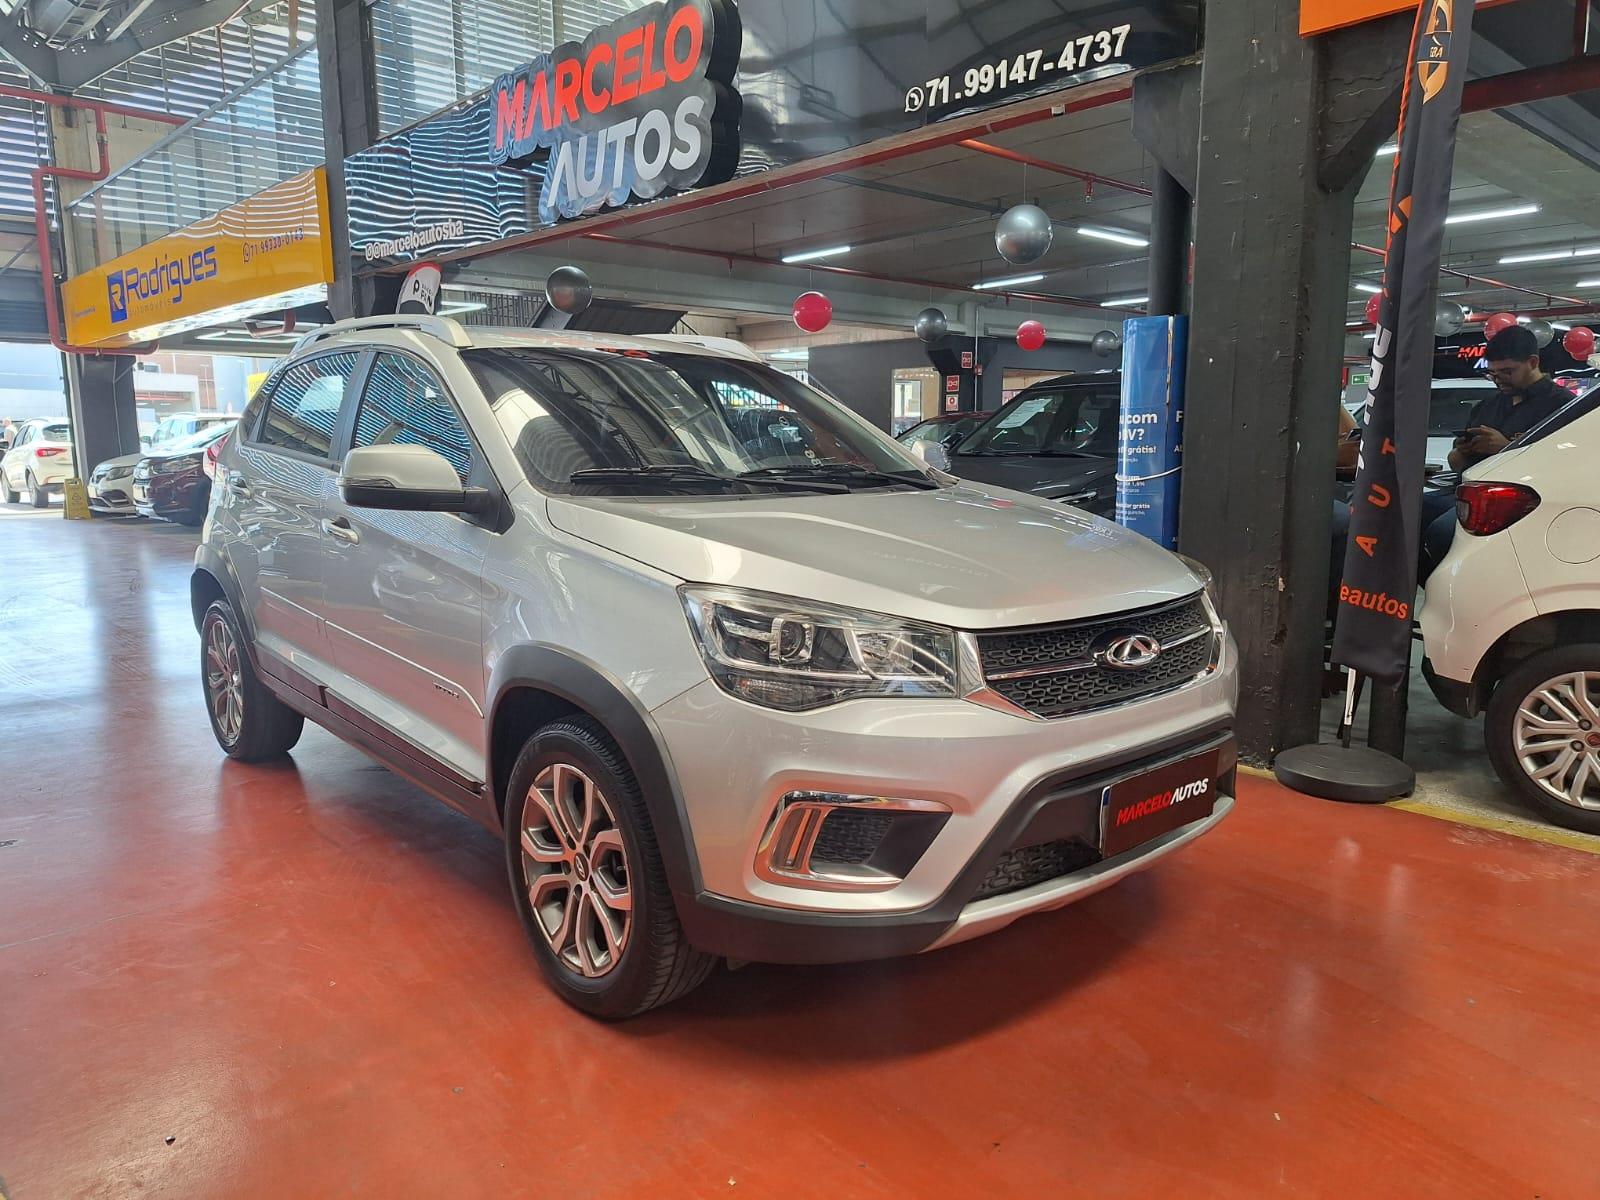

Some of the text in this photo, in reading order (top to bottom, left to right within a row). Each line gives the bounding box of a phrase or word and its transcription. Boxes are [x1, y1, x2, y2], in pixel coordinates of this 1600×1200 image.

[496, 6, 704, 150] MARCELO
[547, 96, 704, 207] AUTOS
[125, 245, 218, 305] Rodrigues
[1127, 444, 1157, 456] grátis!
[1339, 583, 1408, 619] eautos
